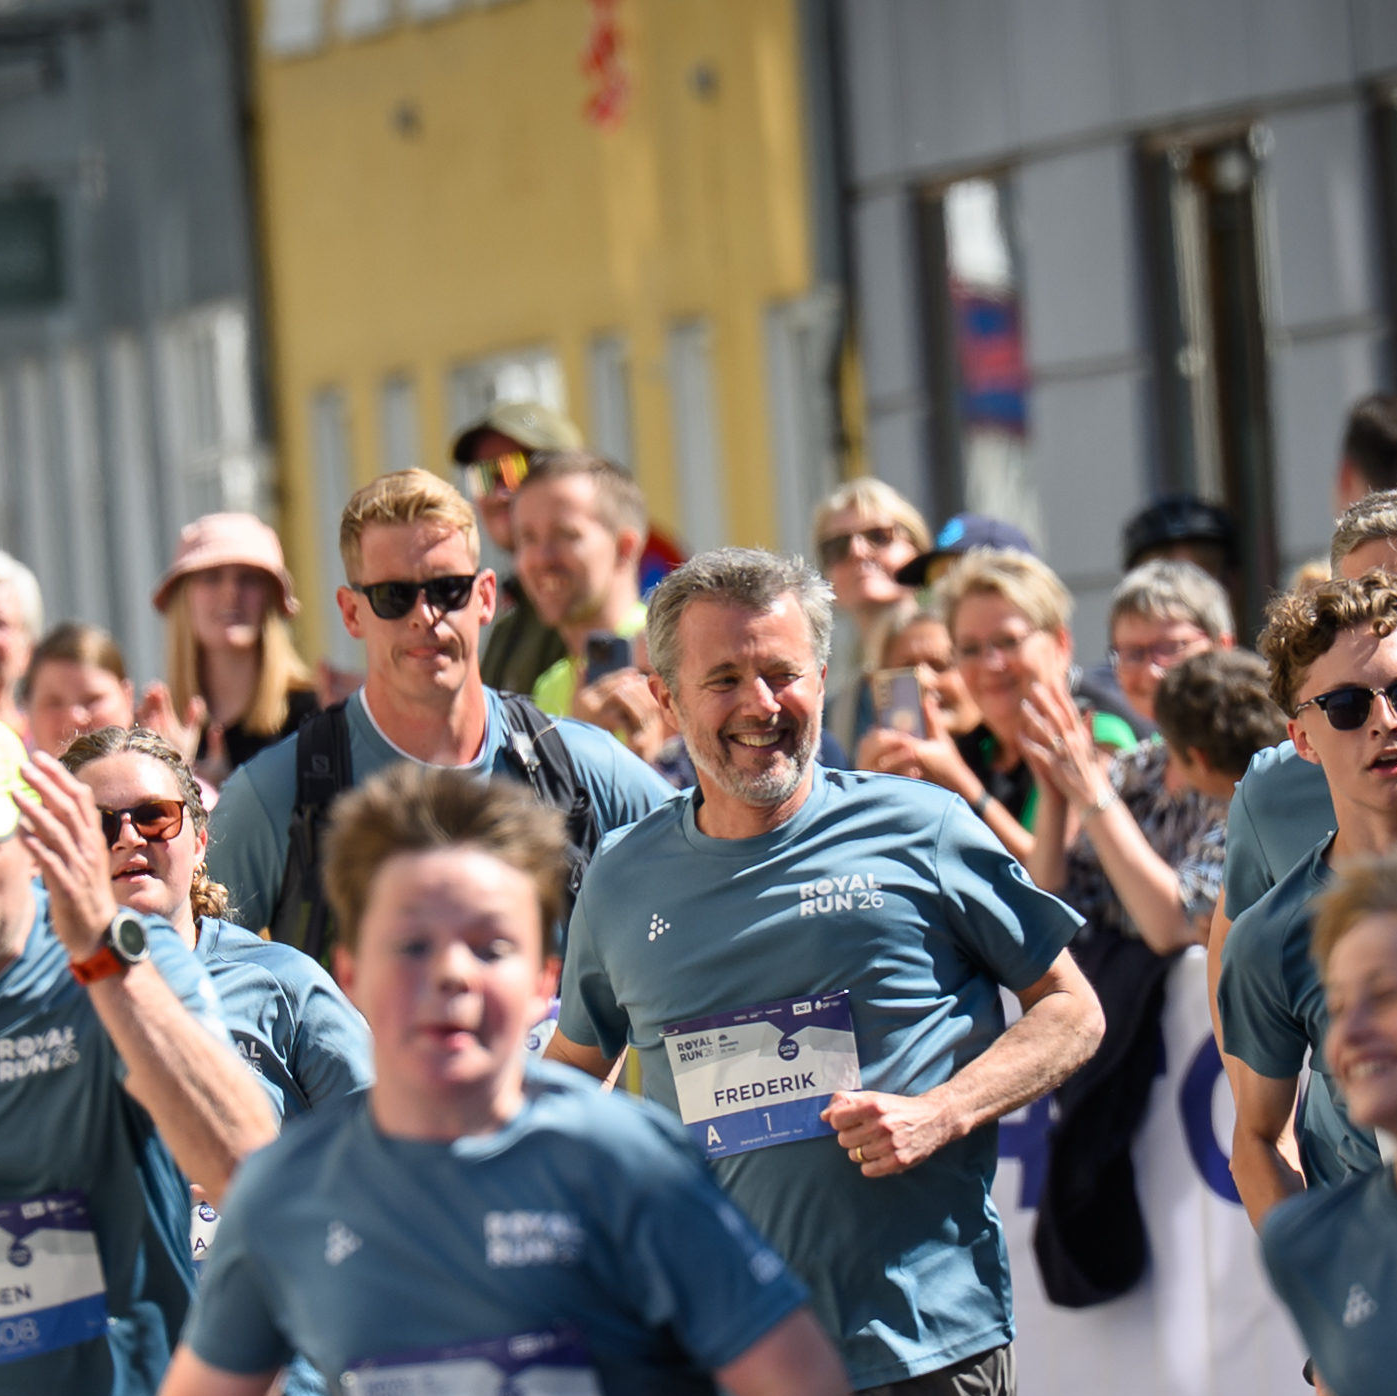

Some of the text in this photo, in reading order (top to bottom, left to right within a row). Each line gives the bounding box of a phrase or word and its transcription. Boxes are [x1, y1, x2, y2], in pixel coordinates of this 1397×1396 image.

[799, 873, 882, 899] ROYAL
[677, 1036, 713, 1052] ROYAL
[714, 1071, 816, 1107] FREDERIK
[707, 1124, 722, 1146] A
[763, 1112, 772, 1132] 1
